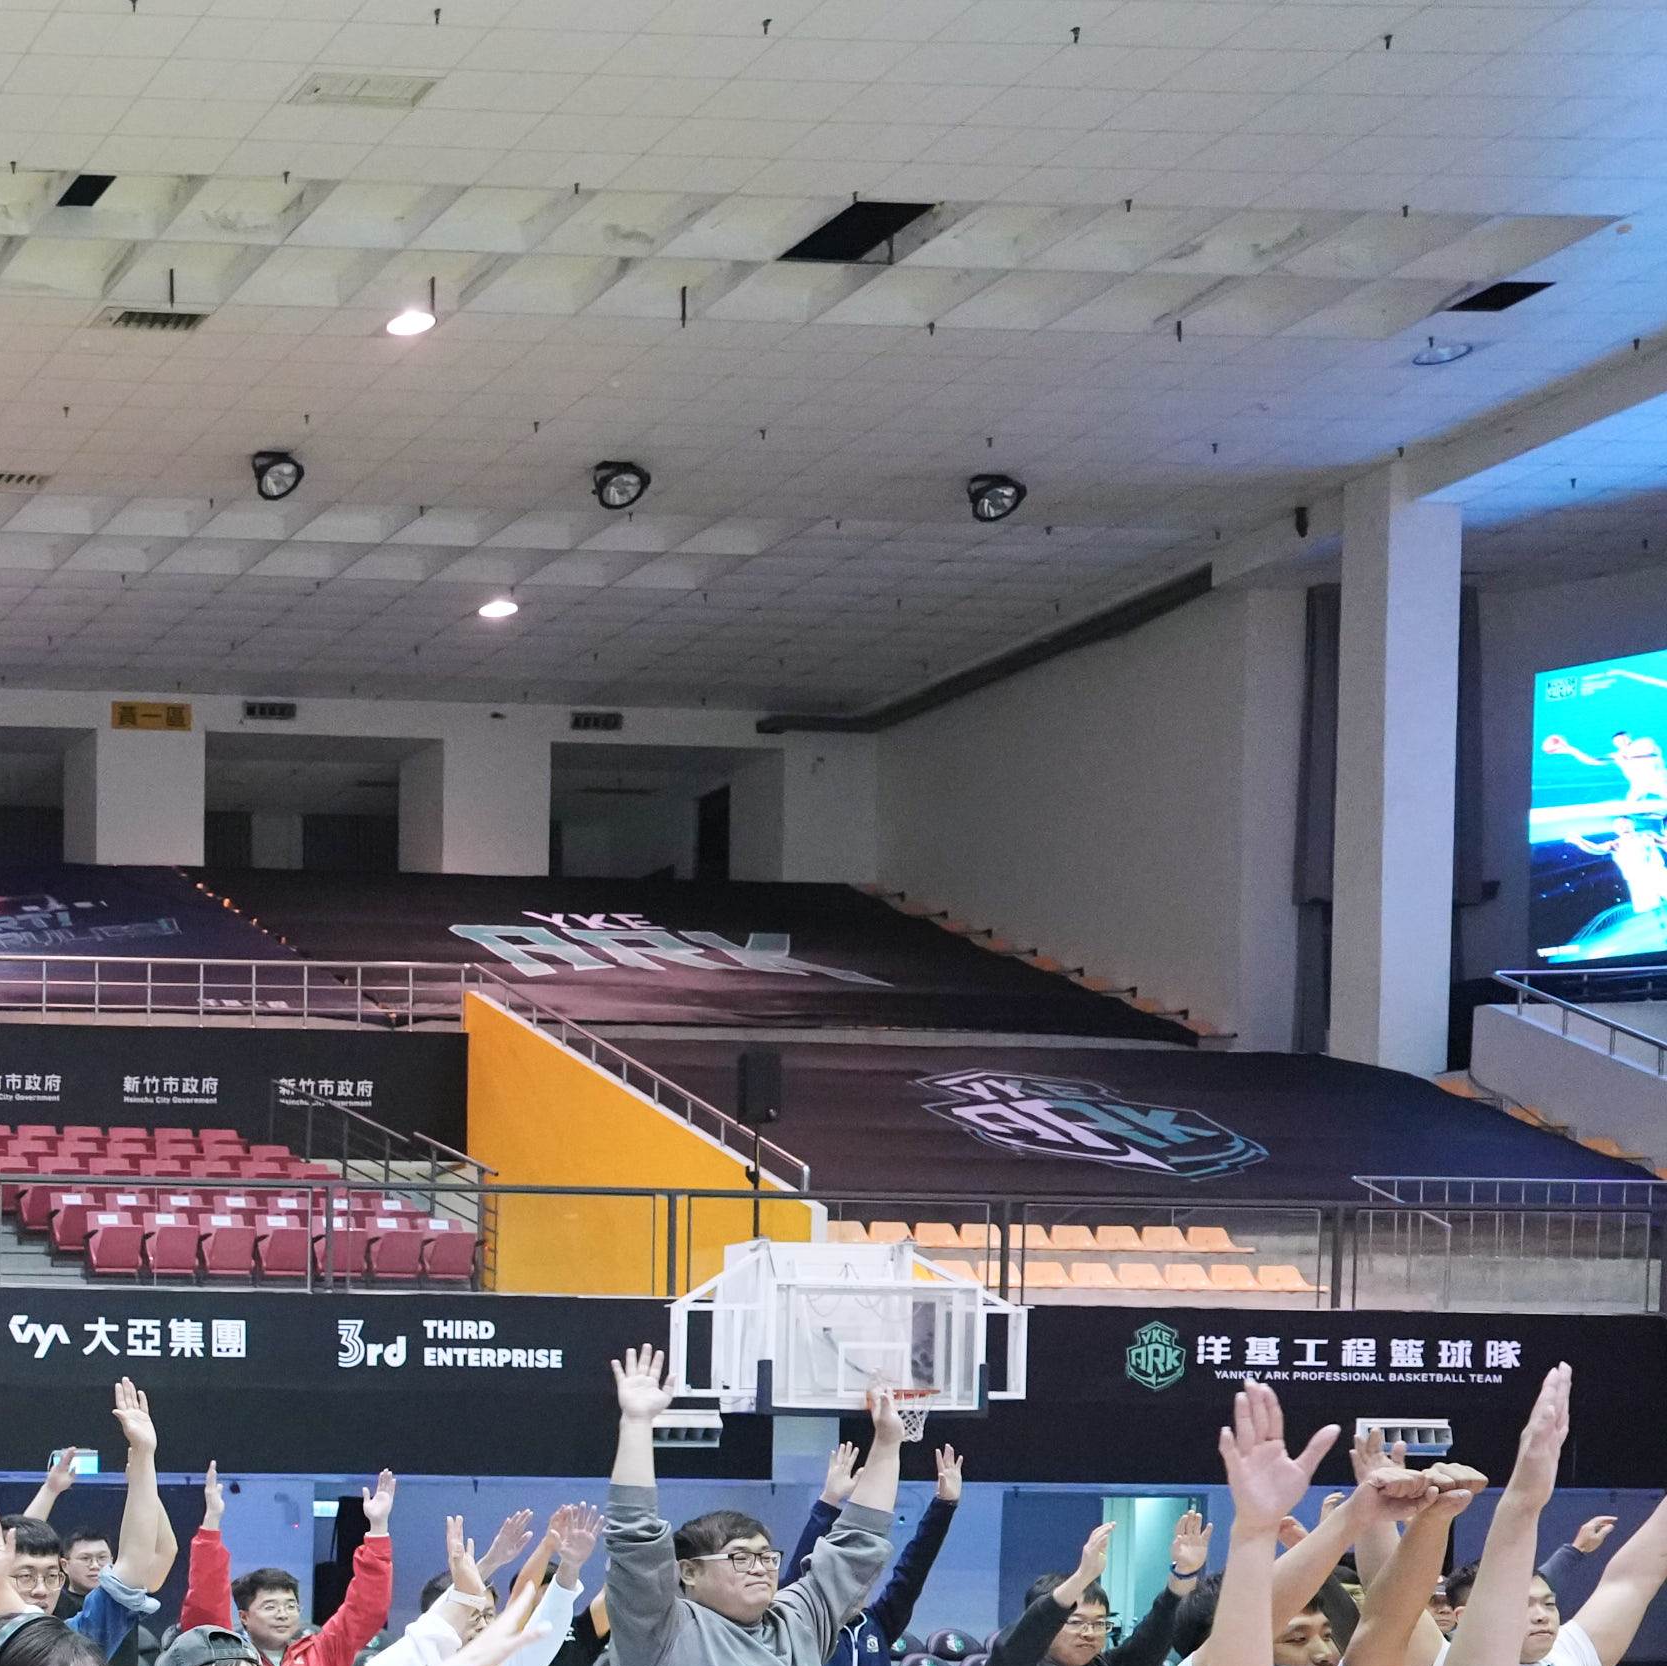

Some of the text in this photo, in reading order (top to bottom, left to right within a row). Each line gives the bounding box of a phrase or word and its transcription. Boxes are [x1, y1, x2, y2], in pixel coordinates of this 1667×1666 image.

[521, 911, 666, 929] YKE
[448, 924, 897, 987] ARK
[123, 1075, 219, 1095] 新竹市政府
[14, 1093, 60, 1102] Government
[155, 1095, 171, 1104] City
[171, 1095, 218, 1104] Government
[82, 1316, 247, 1358] 大亞集團
[422, 1319, 496, 1340] THIRD
[1140, 1328, 1172, 1345] YKE
[337, 1319, 407, 1368] 3rd
[1196, 1335, 1522, 1368] 洋基工程籃球隊
[423, 1346, 563, 1369] ENTERPRISE
[1130, 1342, 1182, 1377] ARK
[1214, 1370, 1503, 1384] YANKEY ARK PROFESSIONAL BASKETBALL TEAM
